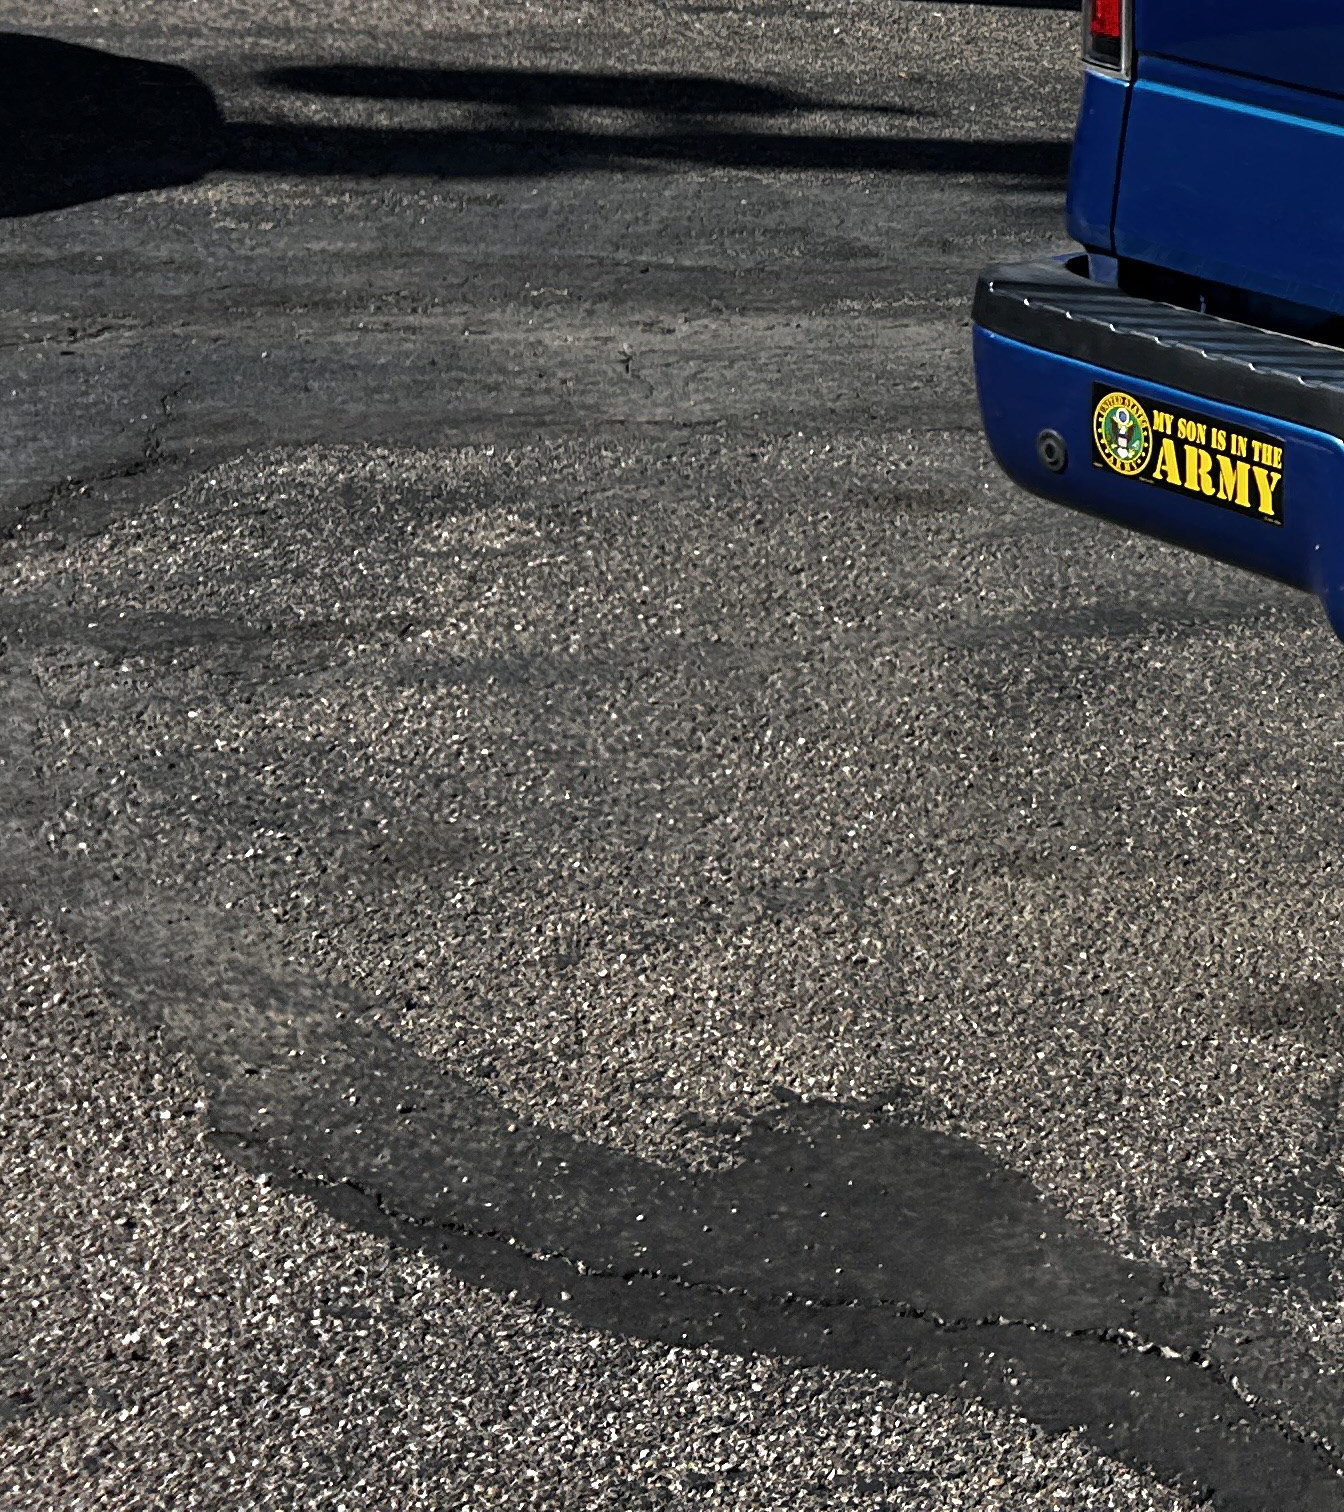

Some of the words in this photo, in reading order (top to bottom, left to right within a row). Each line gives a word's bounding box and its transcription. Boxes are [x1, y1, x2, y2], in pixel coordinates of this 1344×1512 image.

[1153, 410, 1174, 435] MY
[1177, 418, 1207, 445] SON
[1211, 427, 1227, 451] IS
[1231, 434, 1248, 458] IN
[1252, 440, 1283, 469] THE
[1152, 437, 1282, 516] ARMY
